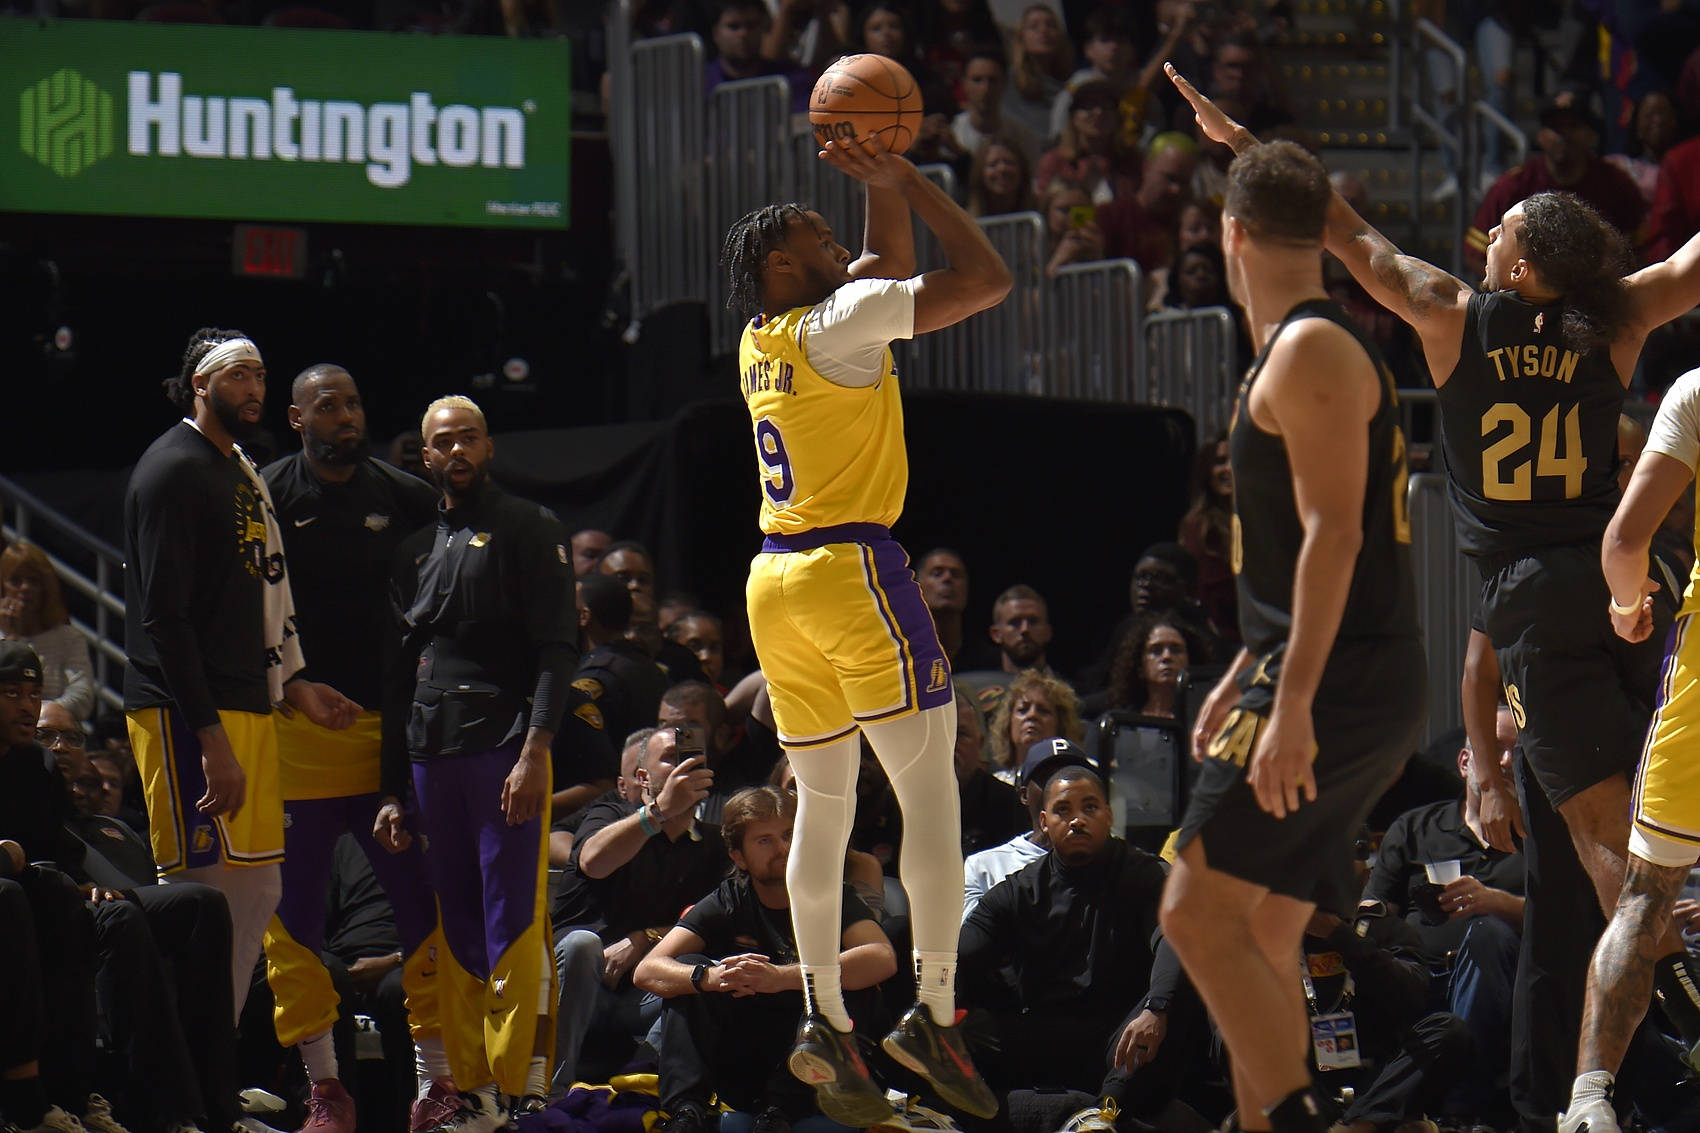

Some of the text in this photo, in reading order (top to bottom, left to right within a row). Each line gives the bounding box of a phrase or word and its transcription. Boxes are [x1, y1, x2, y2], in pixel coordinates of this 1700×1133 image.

[128, 71, 526, 188] Huntington
[775, 361, 797, 396] JR.
[1487, 345, 1580, 384] TYSON
[756, 415, 797, 511] 9
[1481, 403, 1588, 501] 24
[1052, 738, 1071, 755] P
